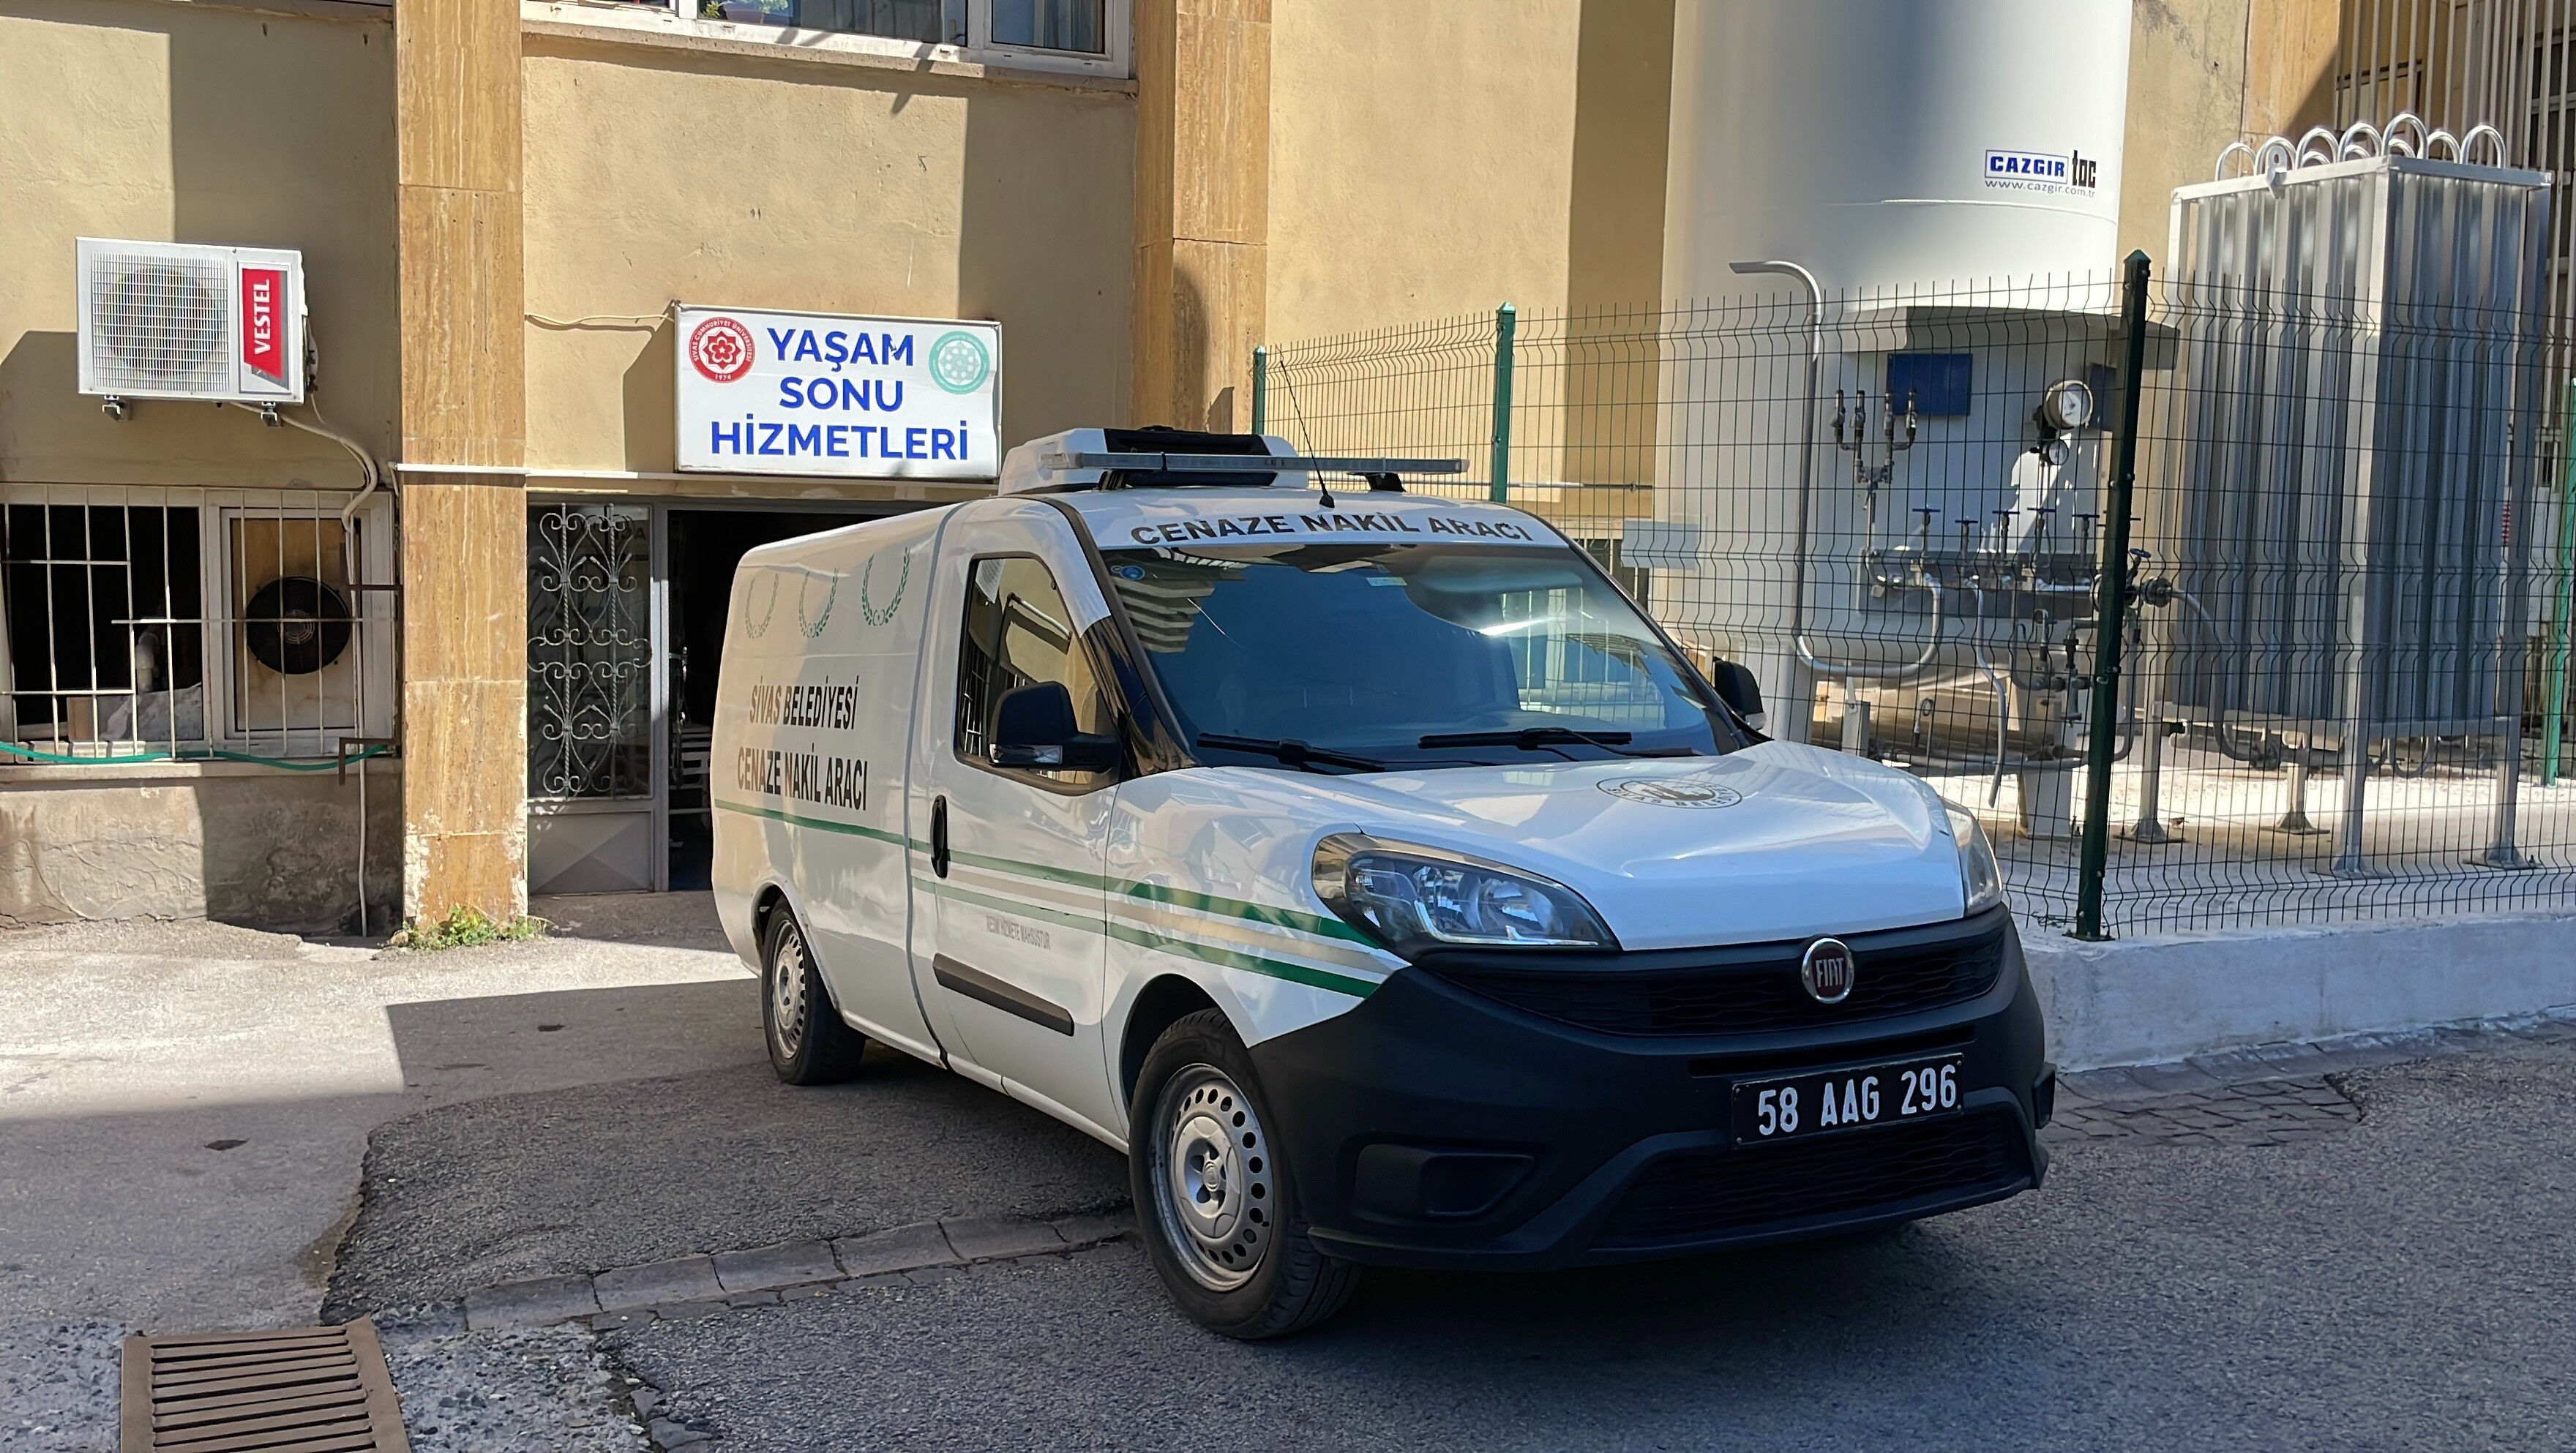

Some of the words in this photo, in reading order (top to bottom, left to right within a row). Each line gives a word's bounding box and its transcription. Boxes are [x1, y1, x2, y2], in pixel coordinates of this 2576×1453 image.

[1985, 180, 2096, 198] www.cazgir.com.tr
[1990, 156, 2065, 177] CAZGIR
[253, 279, 272, 356] VESTEL
[766, 327, 914, 372] YAŞAM
[779, 376, 904, 413] SONU
[711, 413, 968, 461] HİZMETLERİ
[1131, 514, 1295, 544] CENAZE
[1303, 511, 1422, 533] NAKİL
[1427, 516, 1535, 541] ARACI
[749, 675, 782, 726] SİVAS
[782, 675, 859, 730] BELEDİYESİ
[737, 746, 782, 796] CENAZE
[785, 743, 821, 803] NAKİL
[825, 756, 868, 811] ARACI
[1815, 956, 1846, 988] FIAT
[1758, 1086, 1799, 1135] 58
[1820, 1075, 1880, 1127] AAG
[1901, 1064, 1957, 1115] 296
